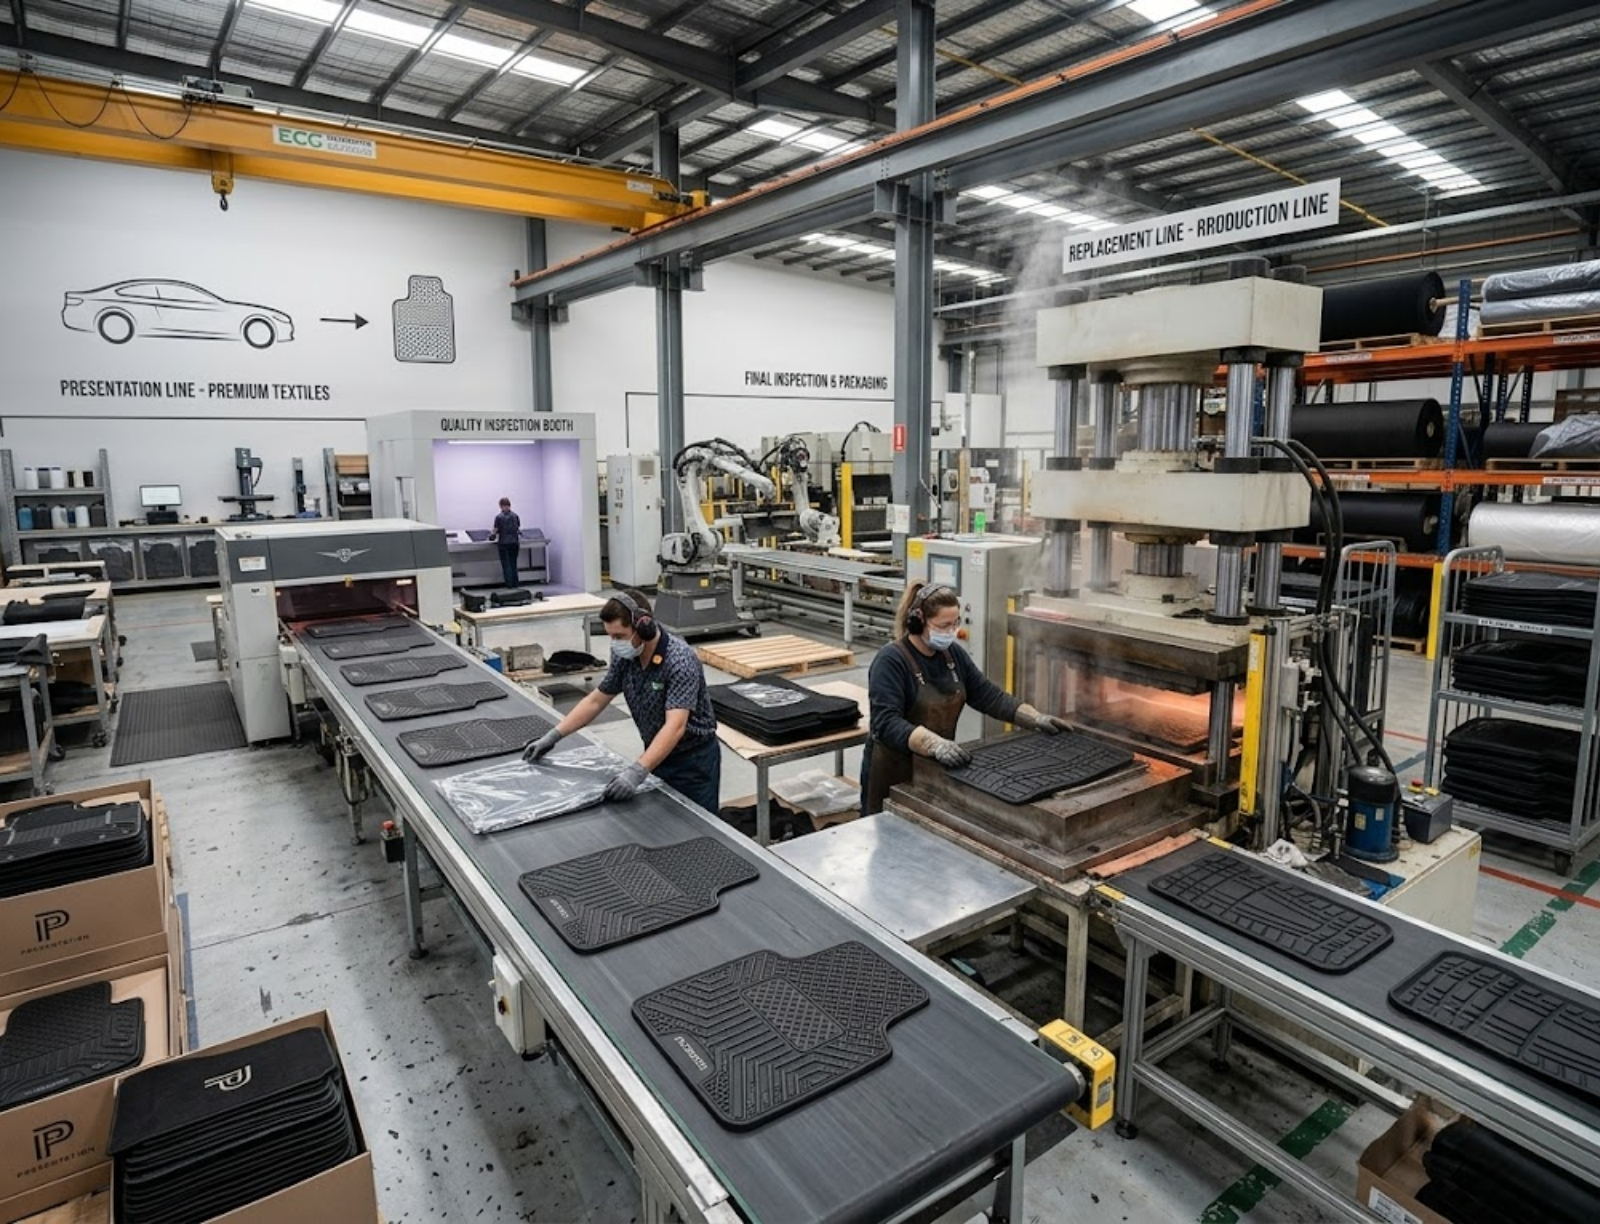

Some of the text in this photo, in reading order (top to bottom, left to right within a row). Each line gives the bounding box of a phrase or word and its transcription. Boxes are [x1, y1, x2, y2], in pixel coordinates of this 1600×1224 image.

[278, 128, 322, 148] ECG
[1069, 229, 1153, 262] REPLACEMENT
[1156, 222, 1184, 245] LINE
[1197, 201, 1289, 237] RRODUCTION
[1293, 193, 1329, 219] LINE
[745, 371, 772, 386] FINAL
[774, 372, 828, 388] INSPECTION
[60, 380, 162, 397] PRESENTATION
[166, 382, 195, 398] LINE
[208, 383, 269, 400] PREMIUM
[271, 384, 330, 401] TEXTILES
[441, 418, 482, 432] QUALITY
[484, 418, 540, 432] INSPECTION
